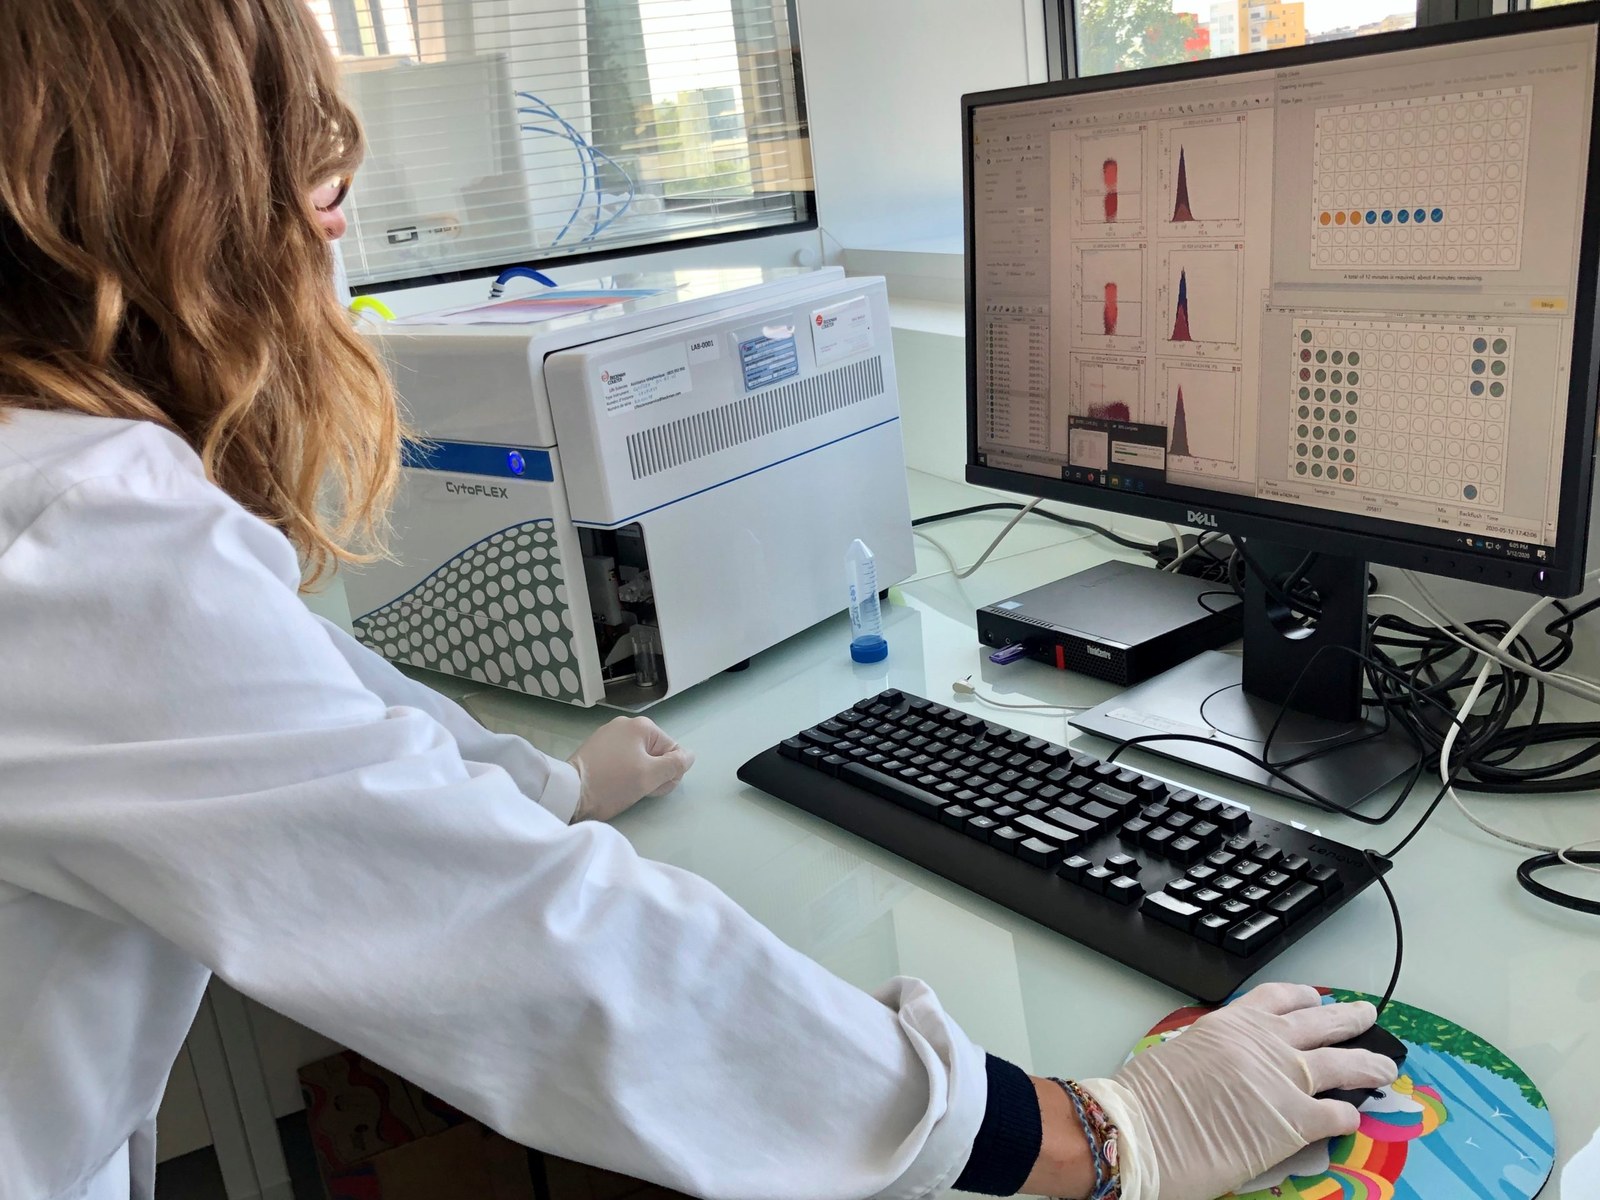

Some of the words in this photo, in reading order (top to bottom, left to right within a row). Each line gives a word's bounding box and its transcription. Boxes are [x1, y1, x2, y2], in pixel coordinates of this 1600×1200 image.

[446, 481, 509, 499] CytoFLEX
[1187, 510, 1218, 527] DELL
[1485, 524, 1514, 535] 2020-05-12
[1307, 844, 1364, 868] Lenovo
